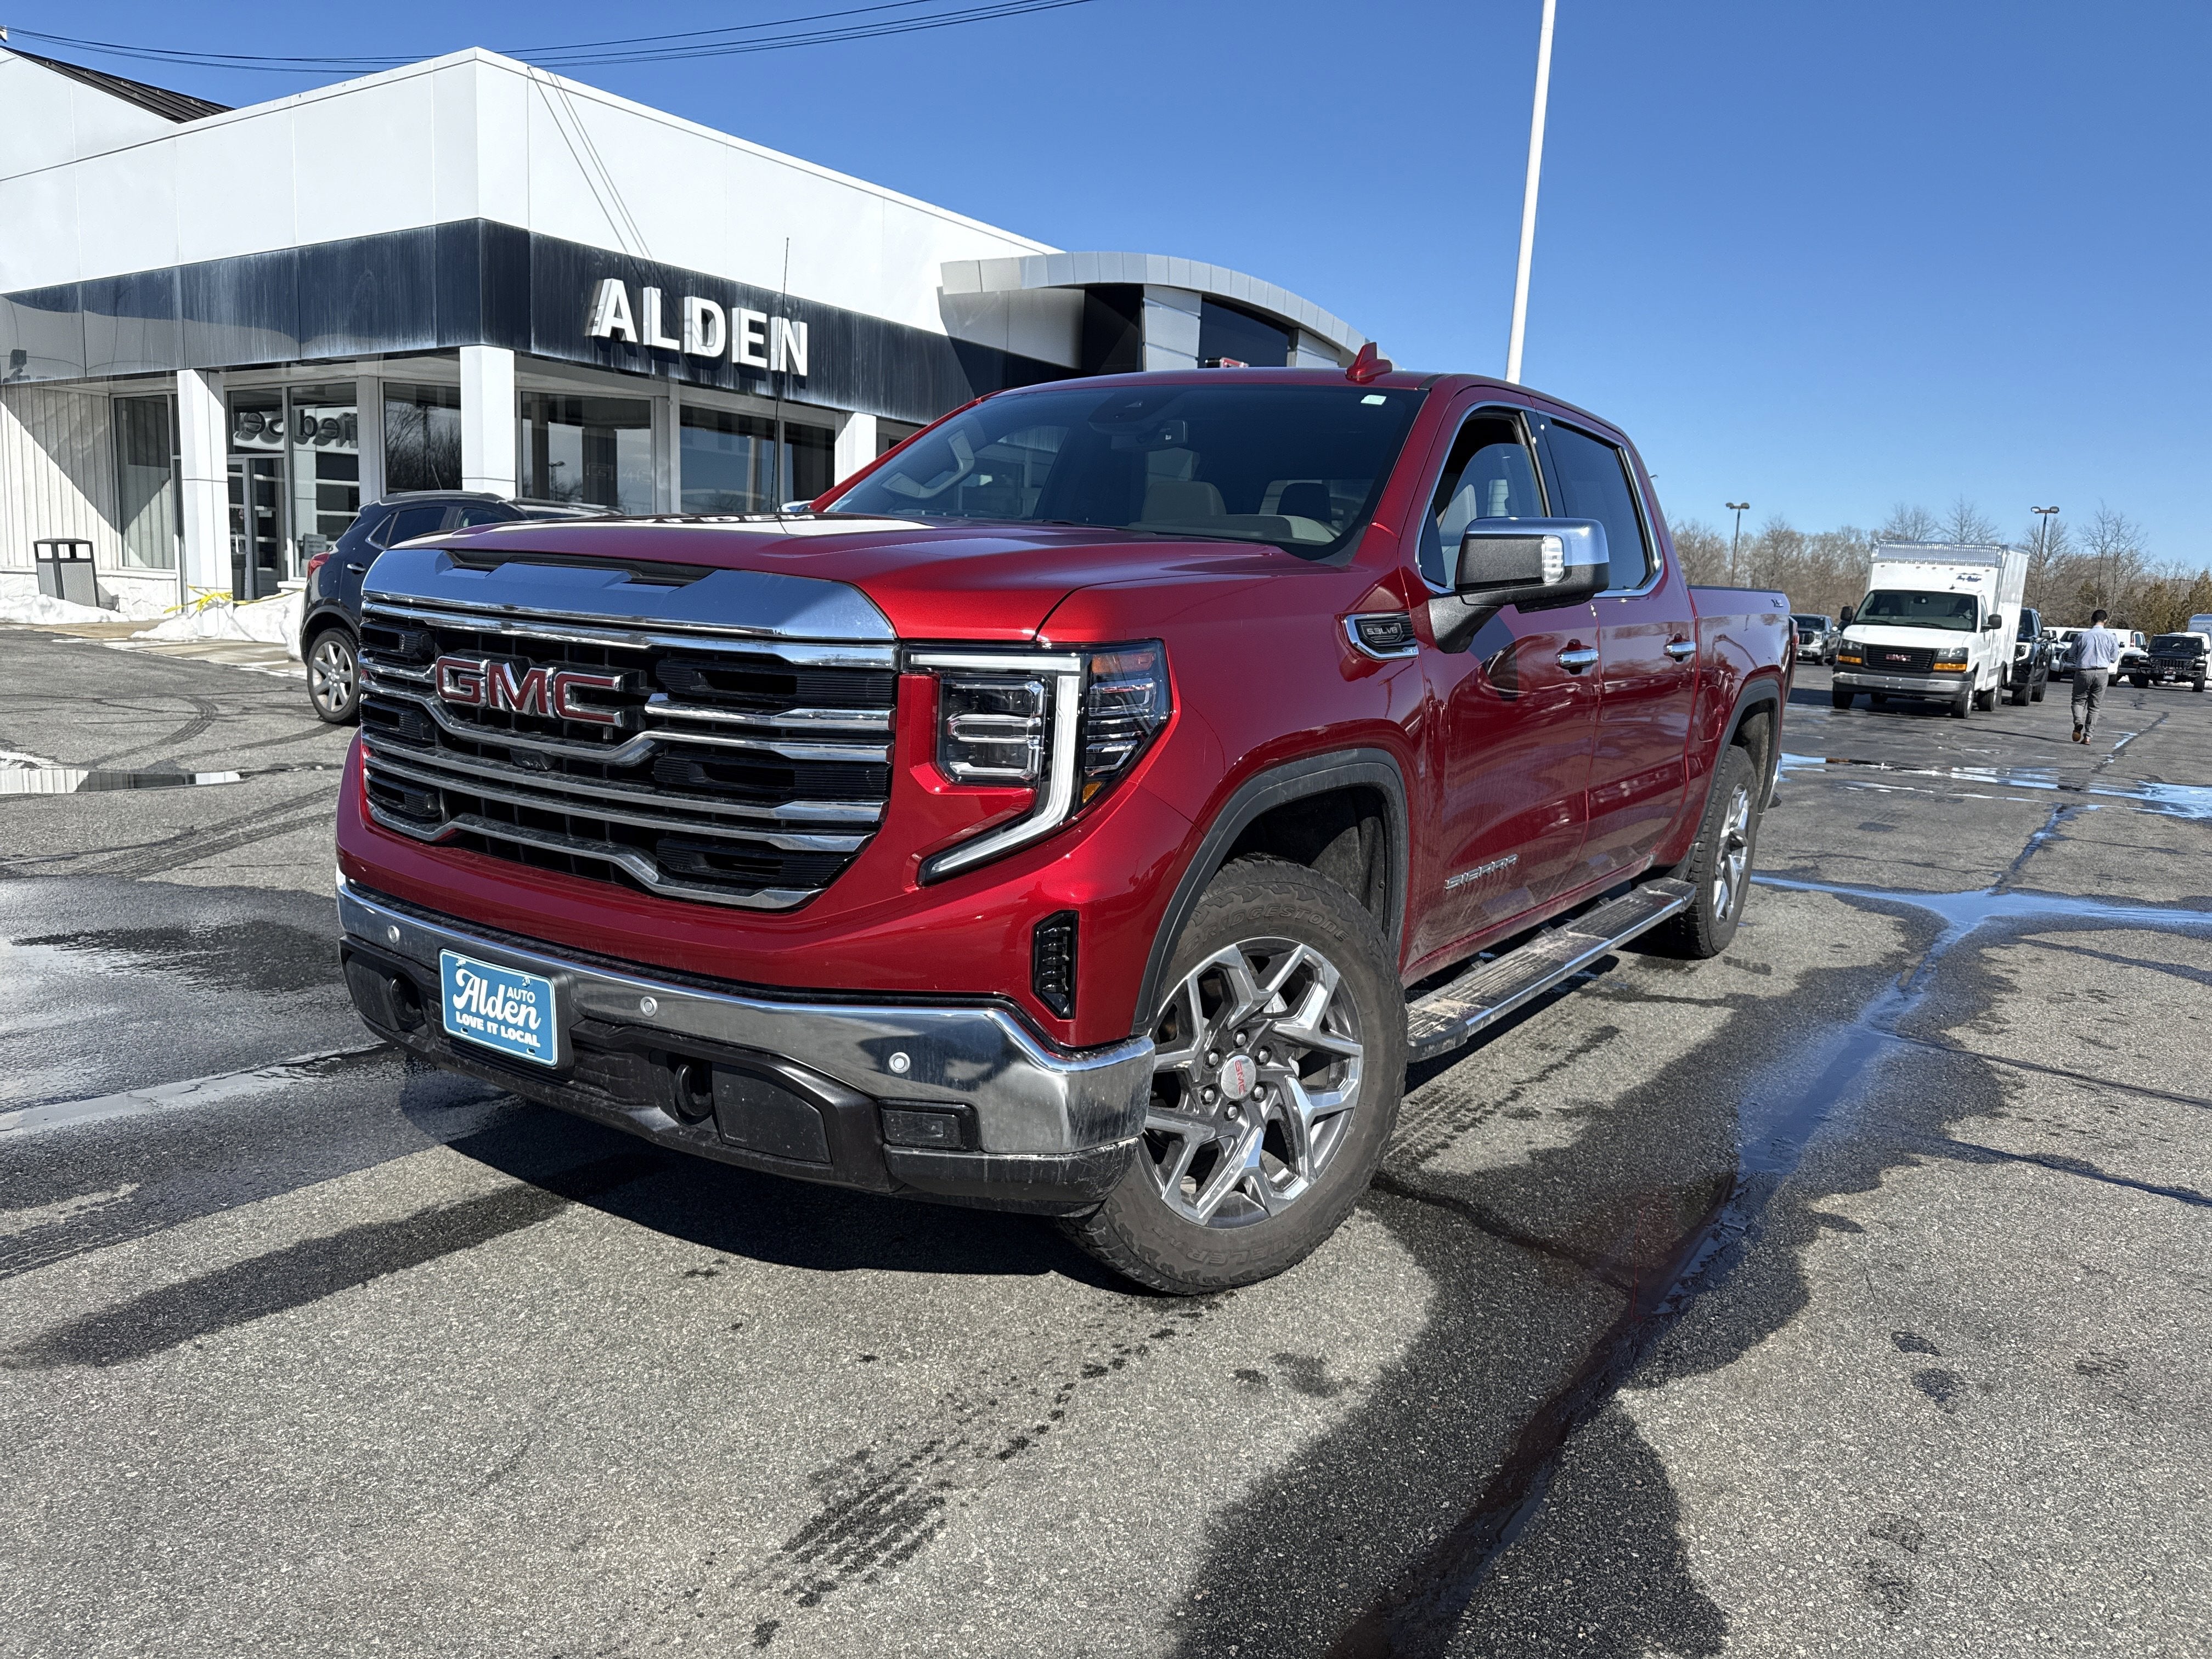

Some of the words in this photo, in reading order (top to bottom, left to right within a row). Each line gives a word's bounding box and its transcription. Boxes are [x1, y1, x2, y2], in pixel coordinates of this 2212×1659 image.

[589, 278, 808, 376] ALDEN
[436, 654, 625, 728] GMC
[1444, 854, 1519, 890] SIERRA
[453, 968, 541, 1030] Alden
[506, 986, 535, 1004] AUTO
[455, 1011, 484, 1031] LOVE
[487, 1021, 499, 1035] IT
[500, 1025, 541, 1048] LOCAL
[1234, 1059, 1246, 1096] GMC
